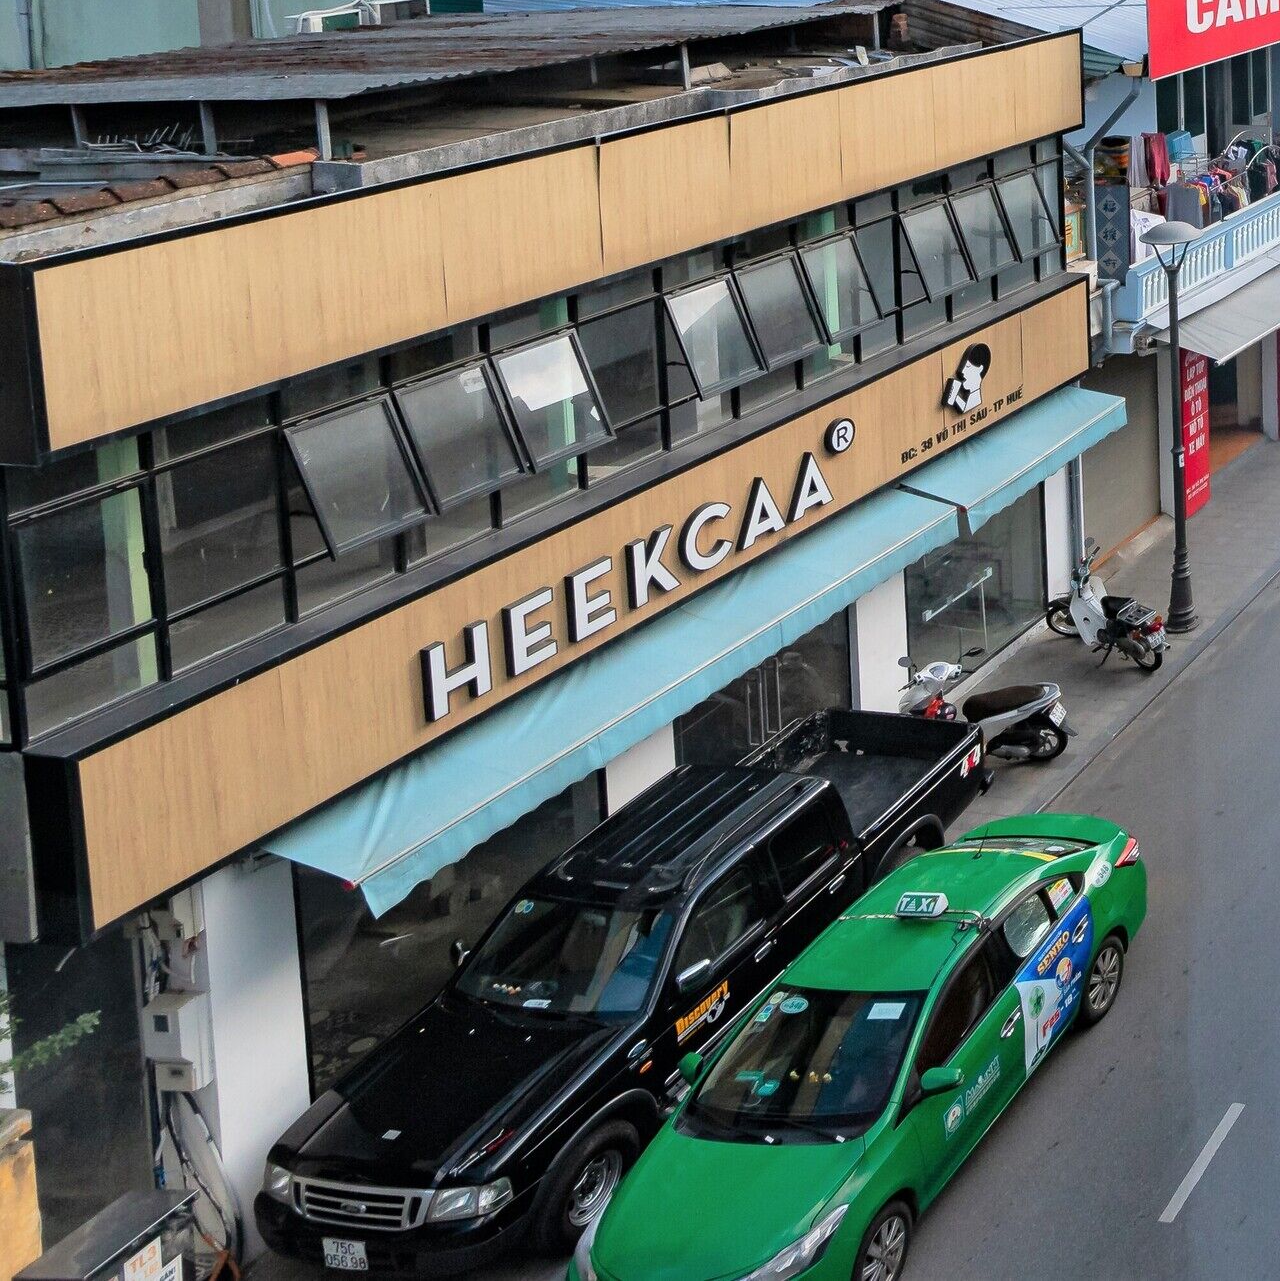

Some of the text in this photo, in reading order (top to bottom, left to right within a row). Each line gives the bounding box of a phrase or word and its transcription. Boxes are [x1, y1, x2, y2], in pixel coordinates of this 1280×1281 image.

[921, 437, 933, 453] 38
[421, 451, 835, 722] HEEKCAA
[332, 1241, 355, 1255] 75C
